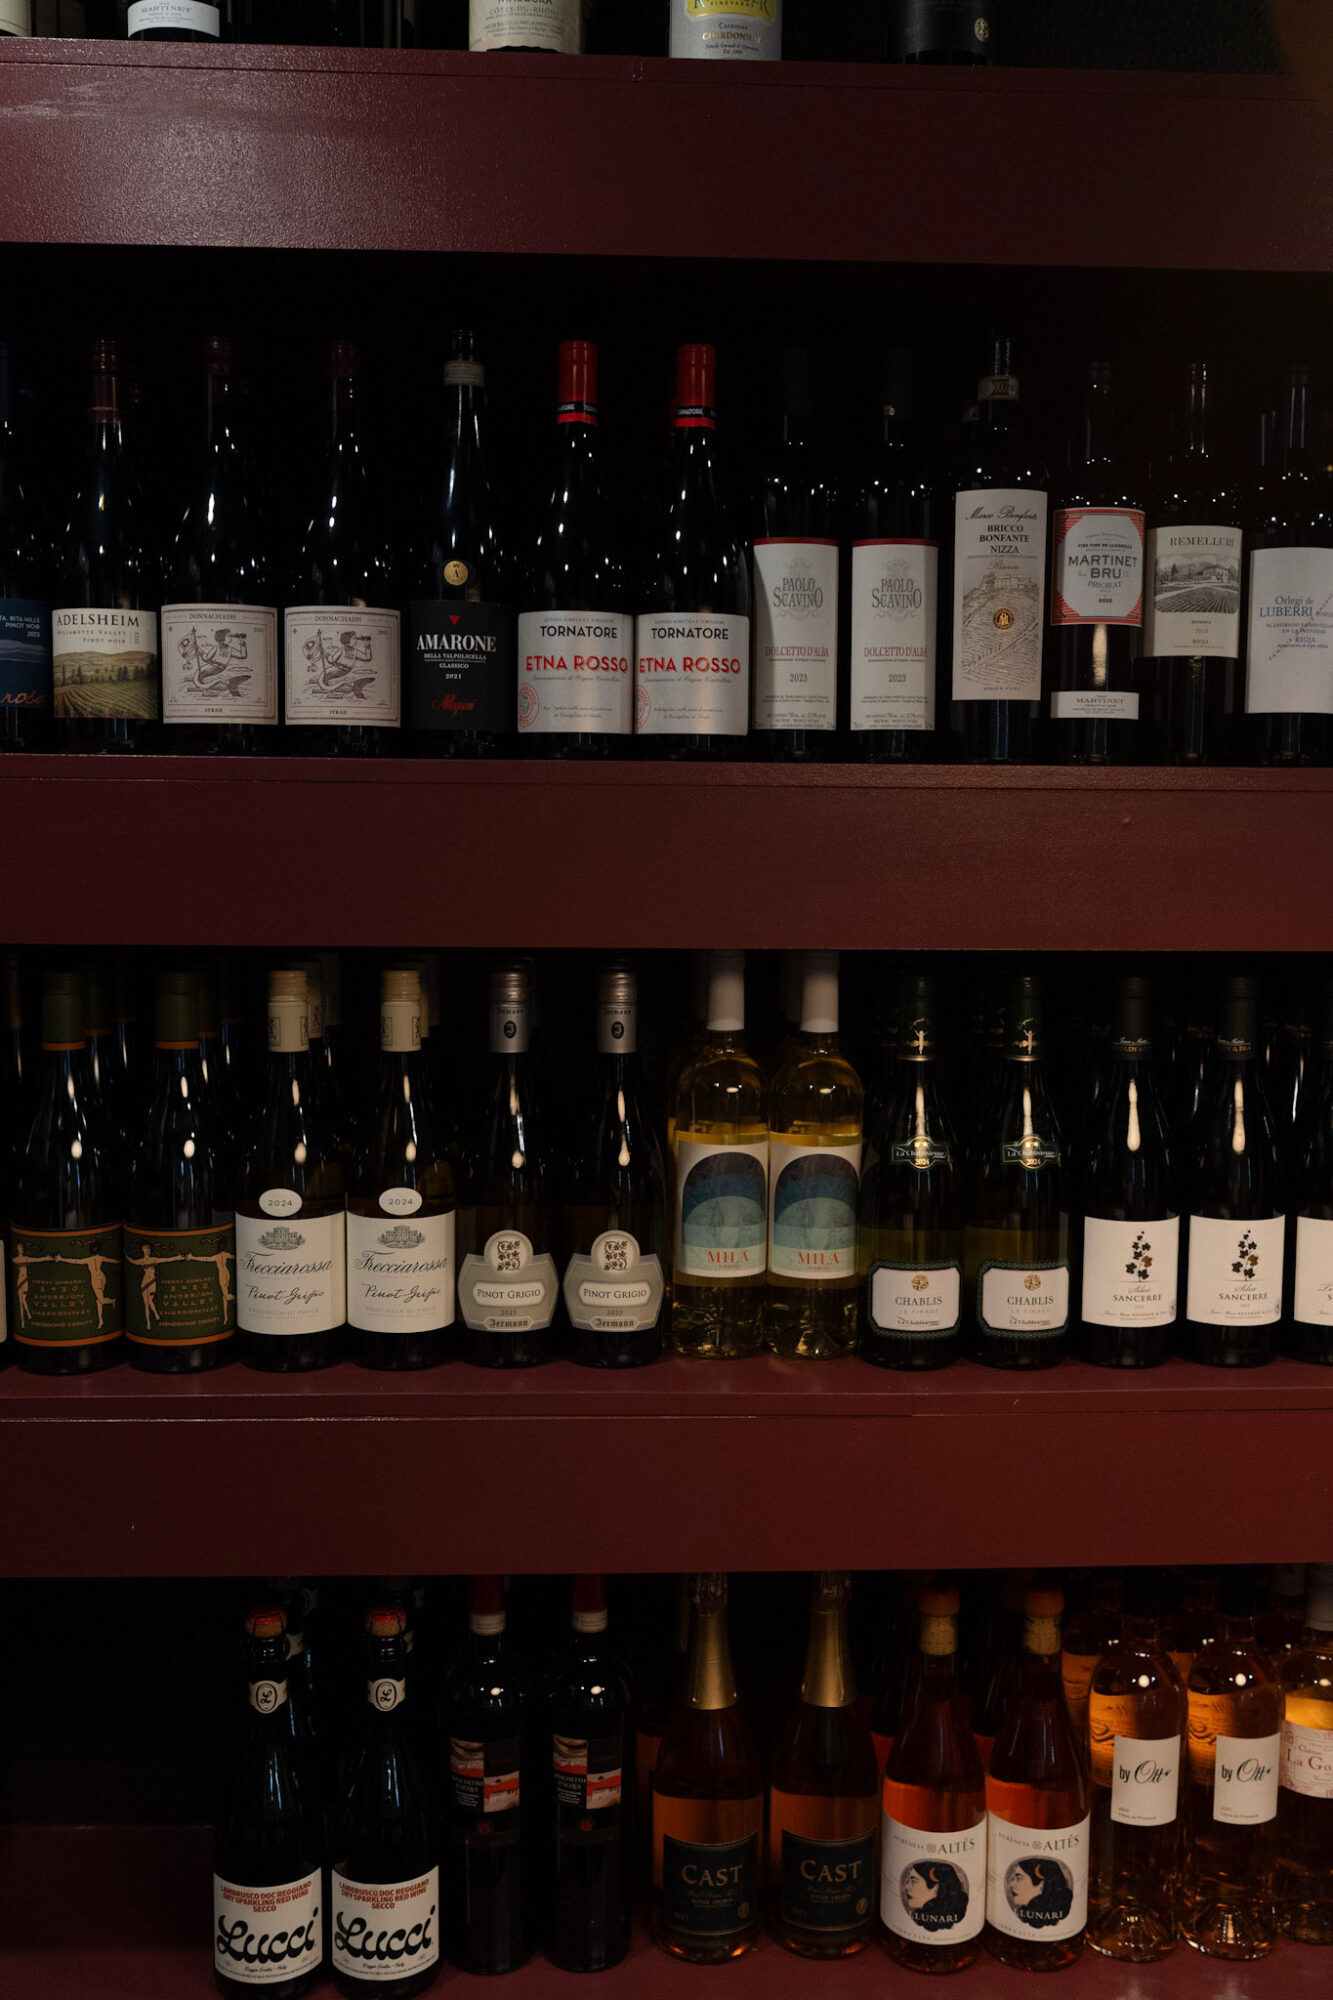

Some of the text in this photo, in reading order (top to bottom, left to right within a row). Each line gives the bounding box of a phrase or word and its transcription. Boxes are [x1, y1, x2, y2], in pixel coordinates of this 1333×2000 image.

[987, 524, 1024, 532] BRICCO
[979, 534, 1030, 543] BONFANTE
[990, 546, 1020, 554] NIZZA
[1068, 554, 1138, 568] MARTINET
[1091, 567, 1122, 579] BRU
[782, 578, 816, 590] PAOLO
[881, 578, 914, 591] PAOLO
[56, 613, 139, 627] ADELSHEIM
[540, 625, 617, 639] TORNATORE
[651, 627, 729, 640] TORNATORE
[416, 633, 497, 652] AMARONE
[765, 646, 806, 657] DOLCETTO
[864, 646, 905, 657] DOLCETTO
[526, 655, 628, 672] ETNA ROSSO
[639, 656, 741, 674] ETNA ROSSO
[268, 1199, 293, 1207] 2024
[388, 1198, 413, 1206] 2024
[707, 1250, 749, 1265] MILA
[798, 1252, 840, 1266] MILA
[895, 1296, 943, 1306] CHABLIS
[1007, 1296, 1054, 1306] CHABLIS
[1113, 1293, 1161, 1302] SANCERRE
[1219, 1292, 1267, 1301] SANCERRE
[1119, 1765, 1131, 1784] by
[1221, 1764, 1233, 1783] by
[681, 1864, 744, 1887] CAST
[800, 1859, 863, 1883] CAST
[260, 1892, 276, 1900] DOC
[277, 1881, 311, 1897] REGGIANO
[395, 1879, 429, 1894] REGGIANO
[236, 1898, 275, 1906] SPARKLING
[276, 1895, 291, 1904] RED
[292, 1888, 309, 1900] WINE
[354, 1894, 393, 1902] SPARKLING
[395, 1893, 409, 1902] RED
[410, 1887, 426, 1898] WINE
[217, 1907, 318, 1963] Lucci
[335, 1905, 435, 1960] Lucci
